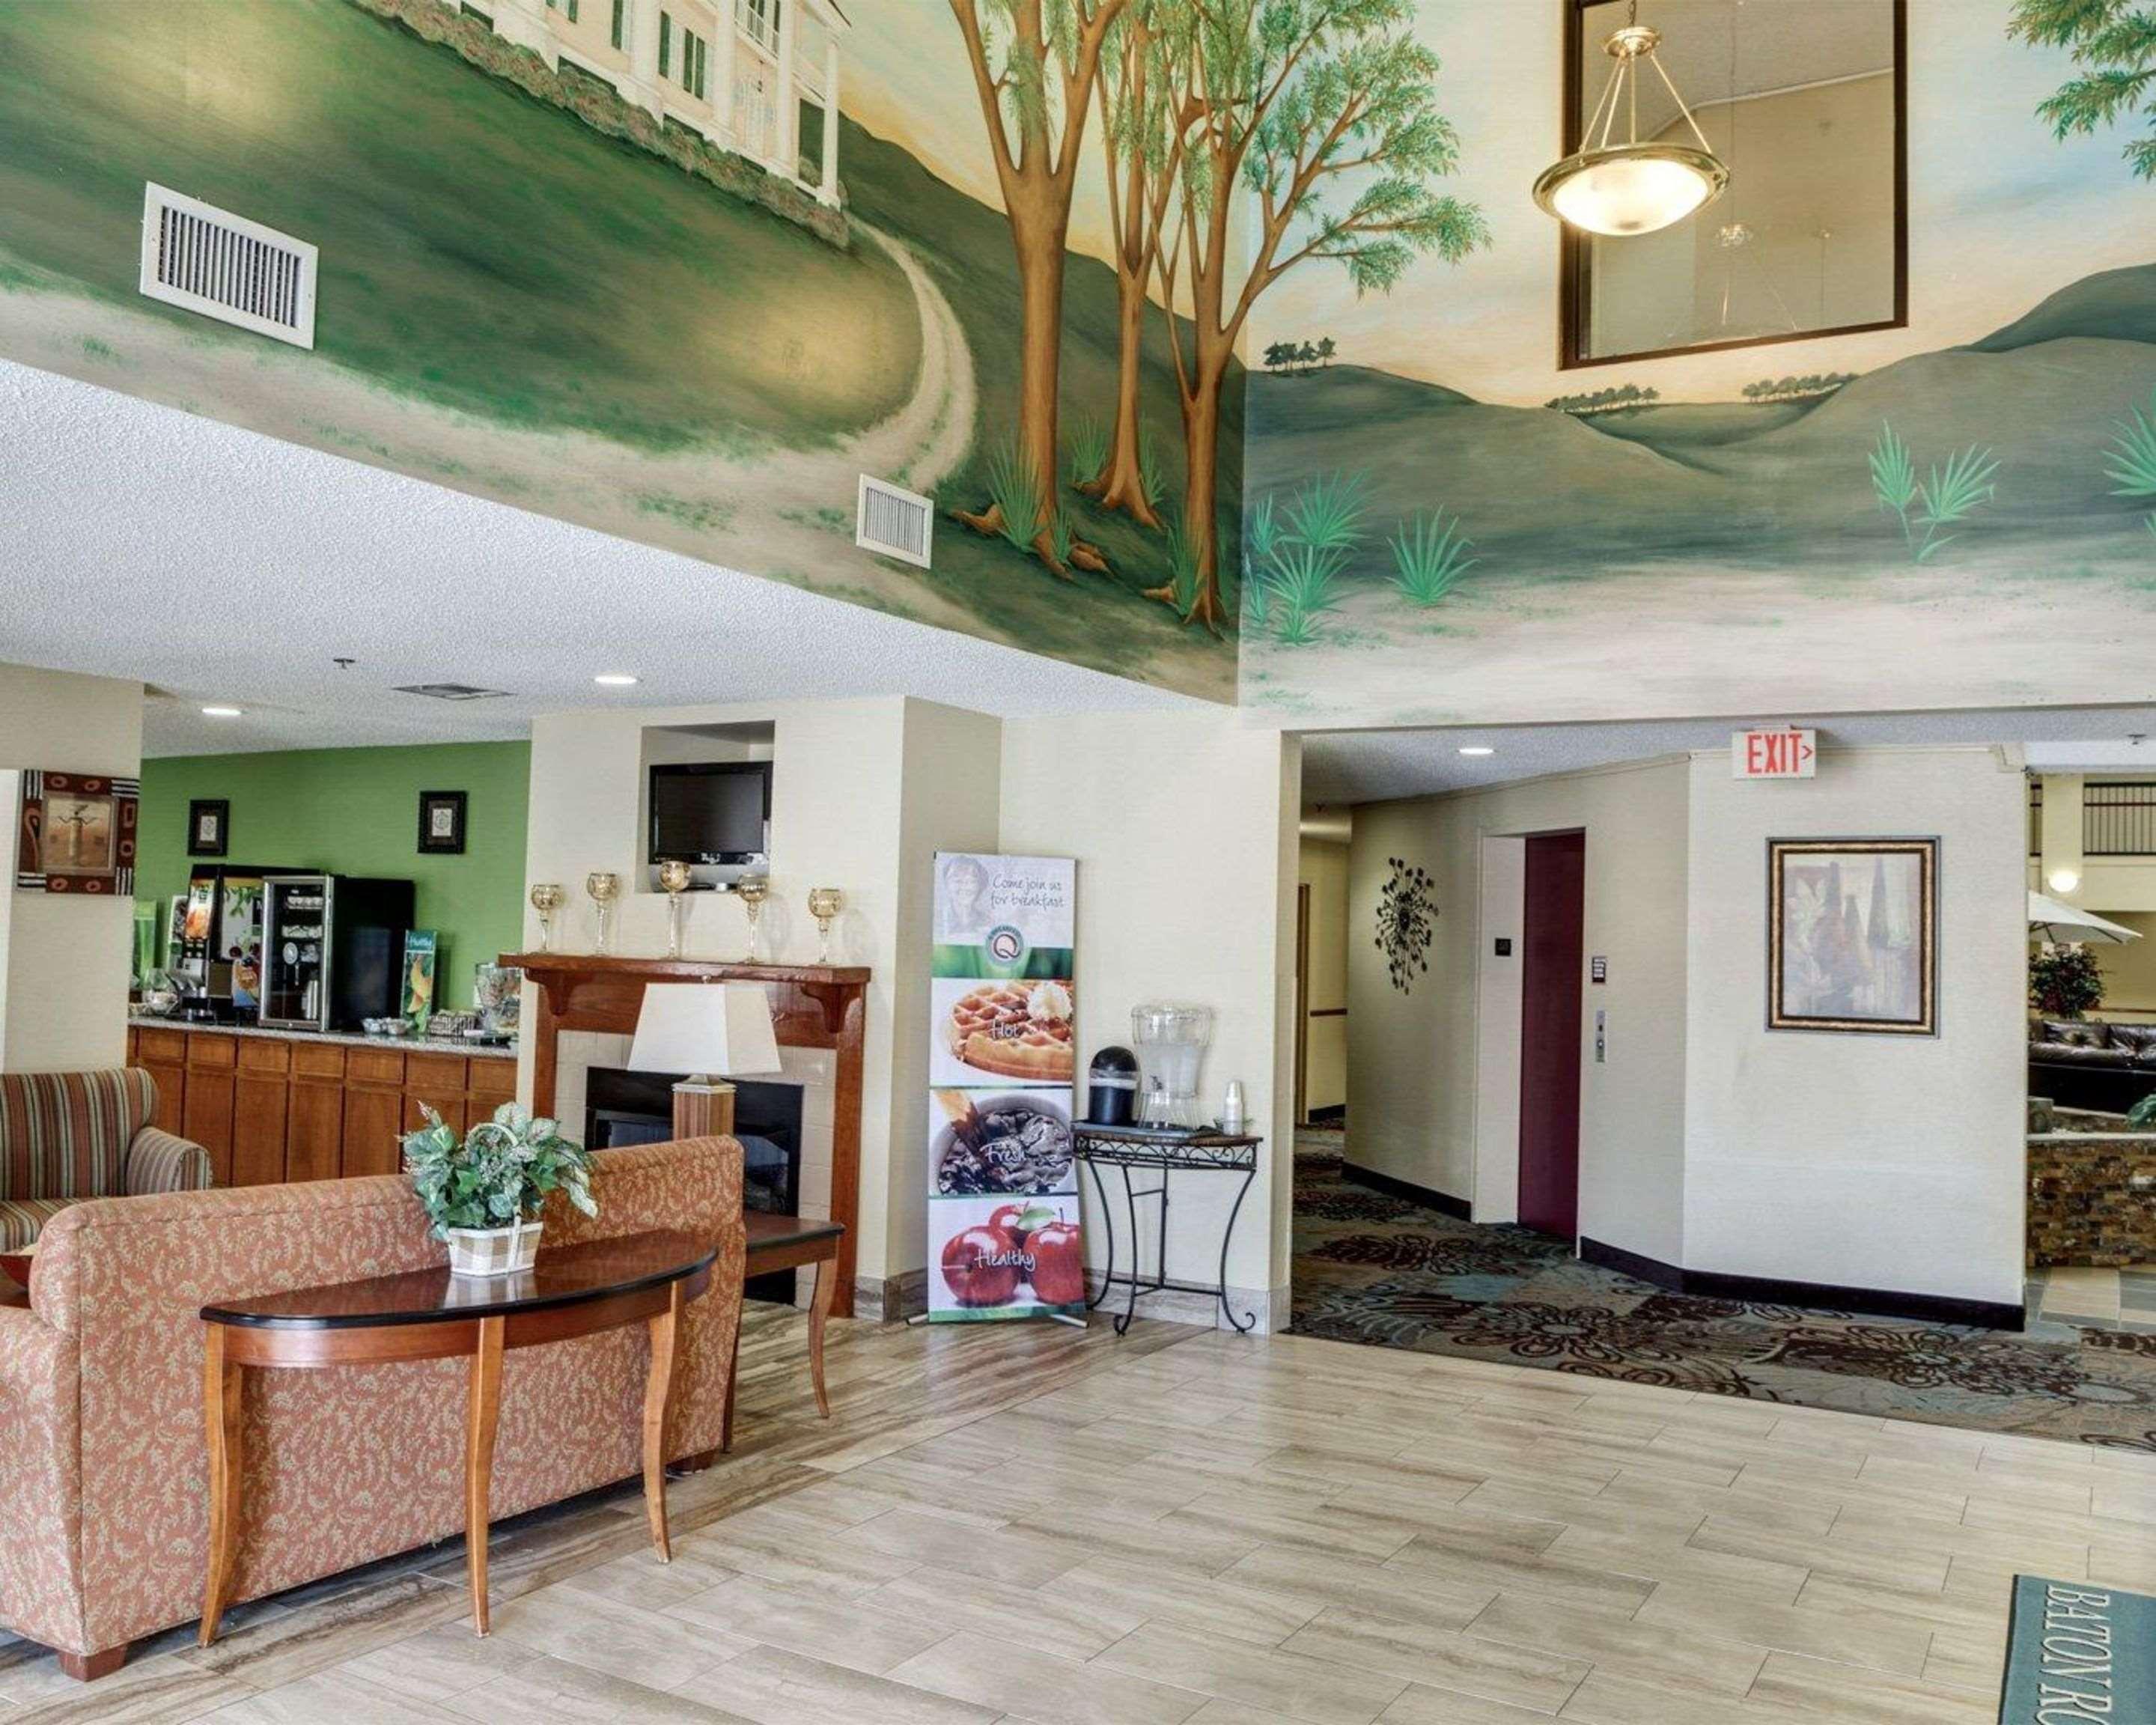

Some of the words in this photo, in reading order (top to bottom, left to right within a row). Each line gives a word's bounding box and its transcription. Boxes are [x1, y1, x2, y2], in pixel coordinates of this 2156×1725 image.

[1747, 734, 1802, 773] EXIT
[993, 874, 1023, 889] Come
[1024, 876, 1047, 895] join
[990, 891, 1008, 909] for
[1011, 892, 1064, 910] breakfast
[990, 1019, 1020, 1040] Hot
[979, 1142, 1026, 1163] Fresh
[974, 1248, 1036, 1272] Healthy
[2040, 1585, 2113, 1689] BATON
